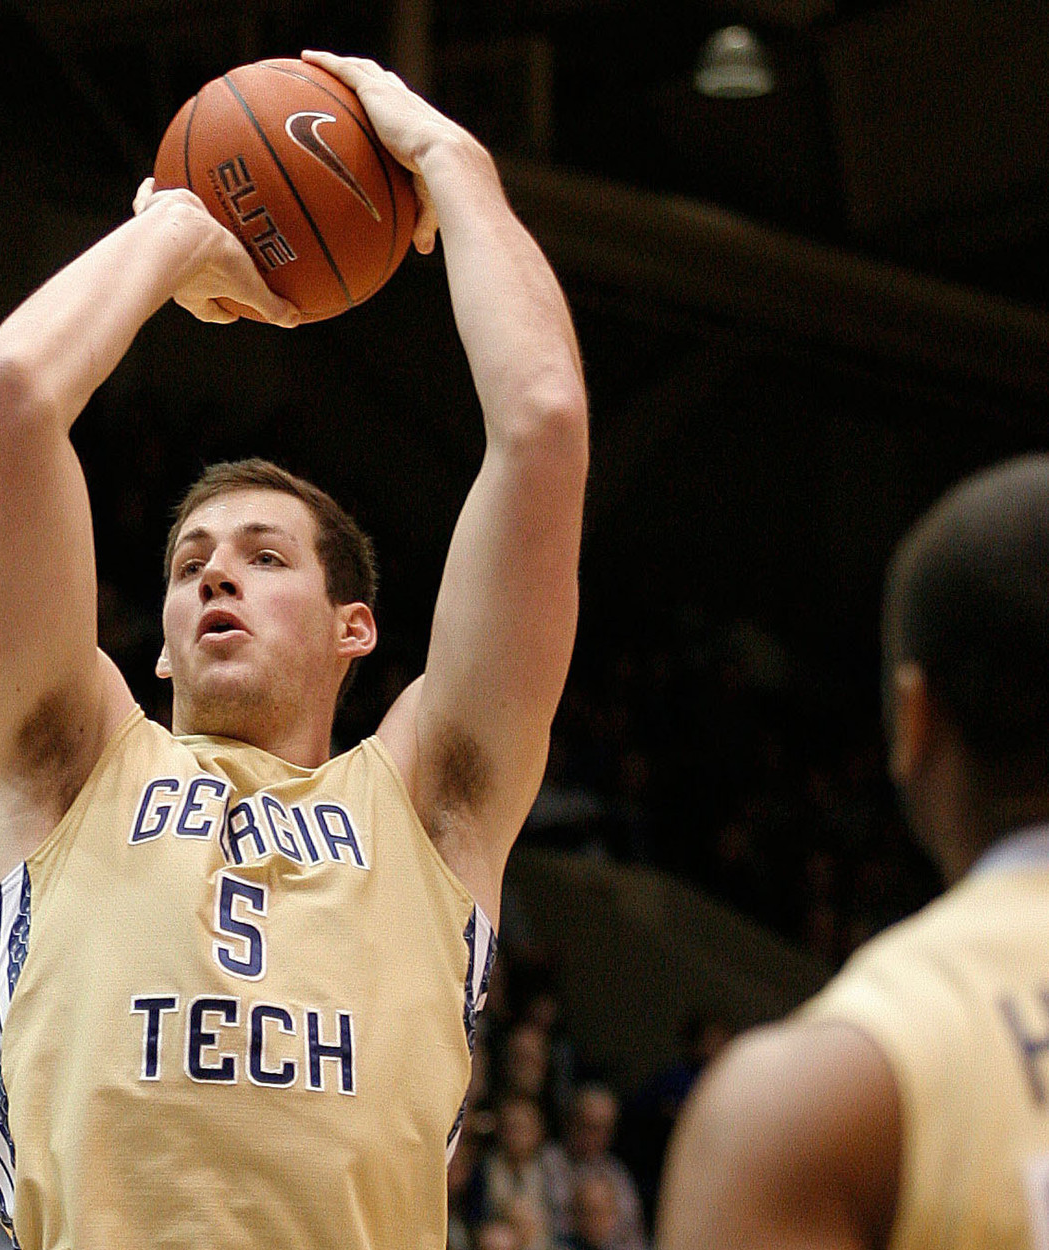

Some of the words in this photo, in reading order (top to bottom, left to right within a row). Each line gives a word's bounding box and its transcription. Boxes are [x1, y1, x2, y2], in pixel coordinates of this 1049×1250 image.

[218, 156, 298, 269] ELITE
[128, 774, 371, 871] GERGIA
[212, 870, 269, 982] 5
[129, 993, 357, 1096] TECH
